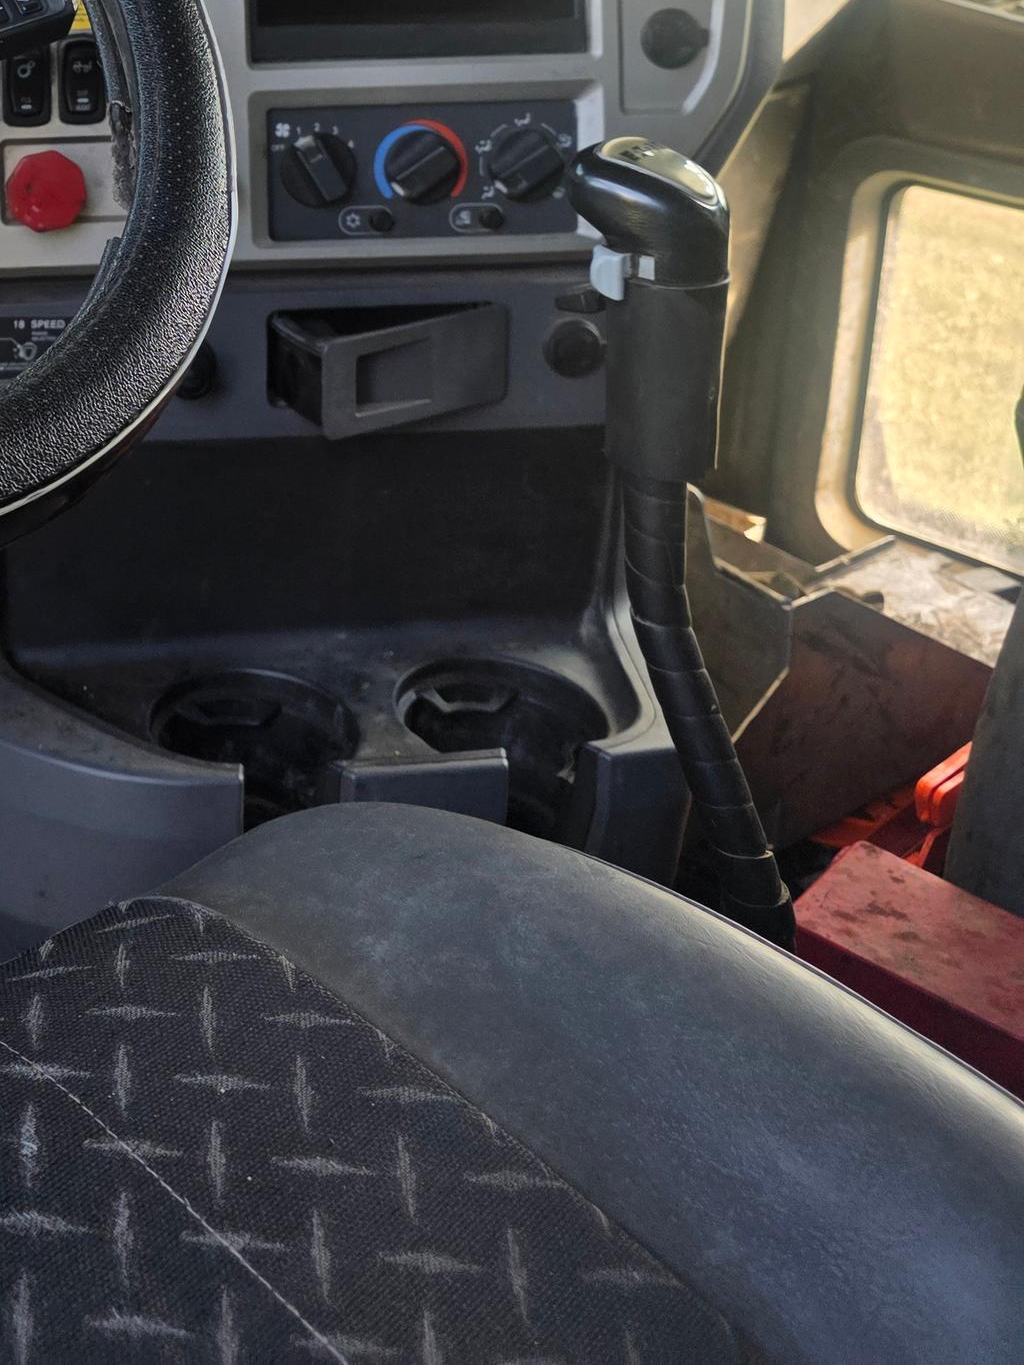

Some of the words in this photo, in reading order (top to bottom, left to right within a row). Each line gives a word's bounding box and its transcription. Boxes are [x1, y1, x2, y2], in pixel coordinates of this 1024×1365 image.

[313, 122, 320, 132] 2
[13, 319, 25, 330] 18
[30, 319, 66, 330] SPEED
